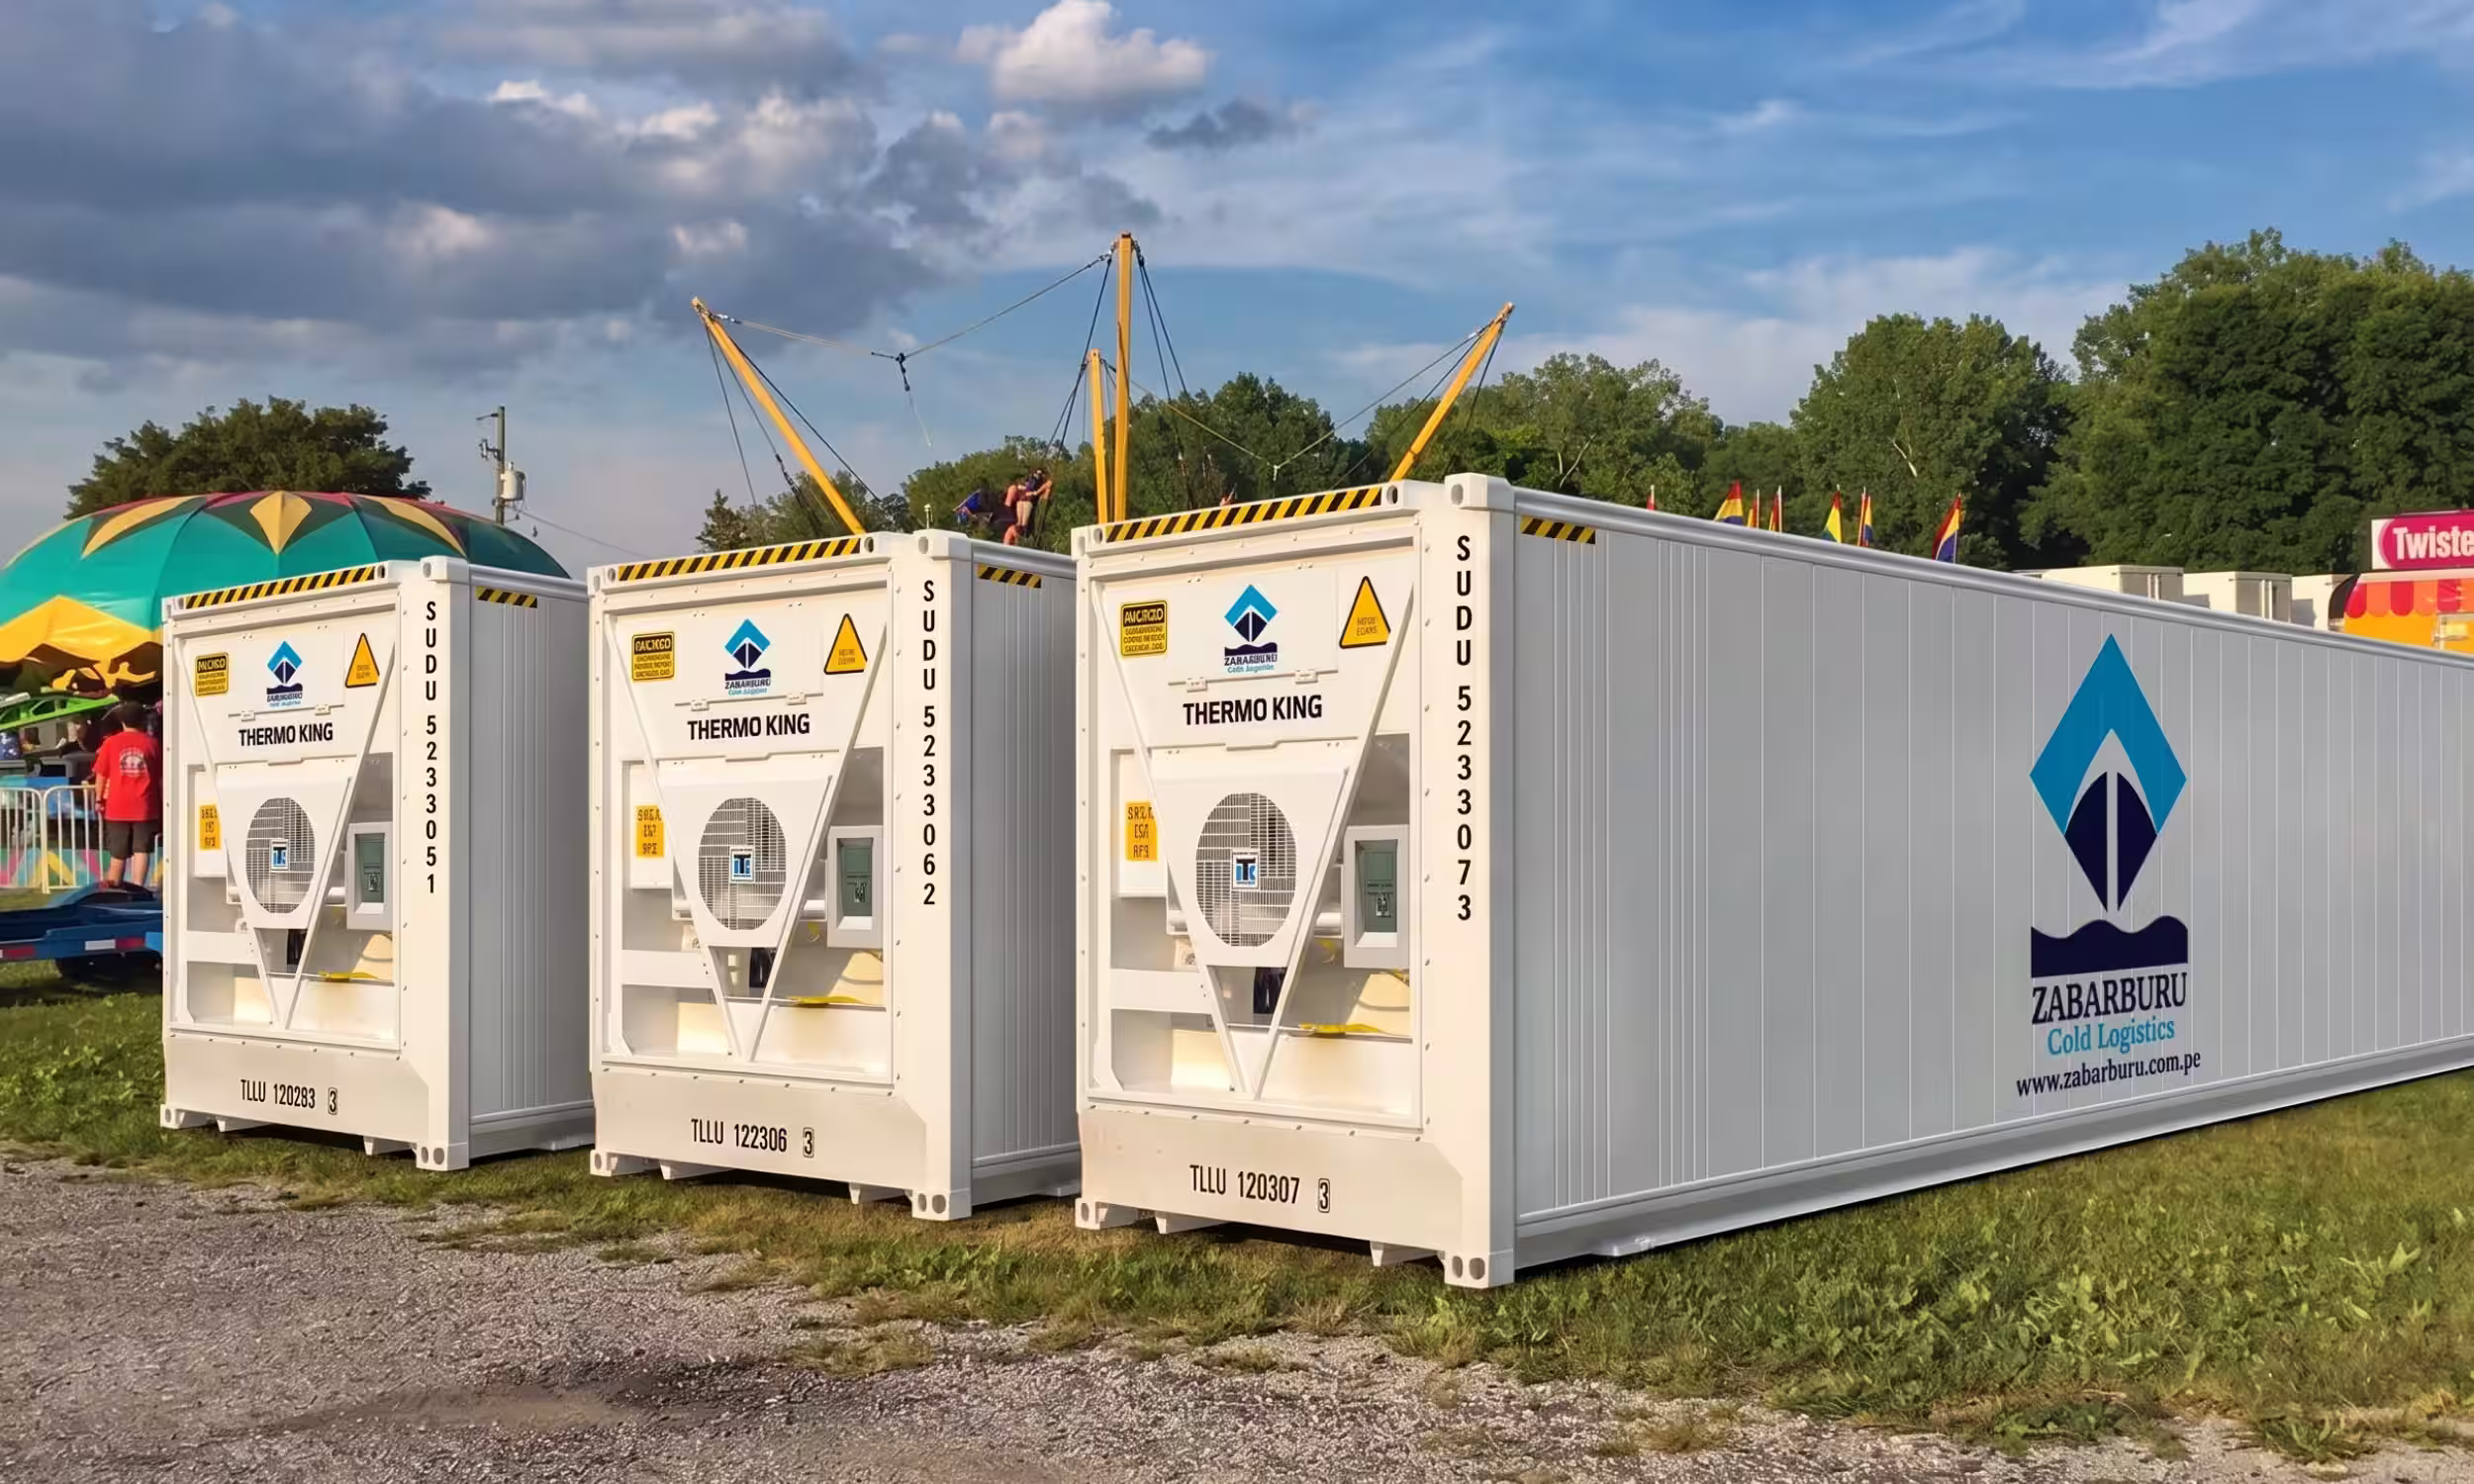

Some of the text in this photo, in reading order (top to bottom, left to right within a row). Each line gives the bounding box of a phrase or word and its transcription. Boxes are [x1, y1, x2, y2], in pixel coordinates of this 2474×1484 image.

[2393, 525, 2474, 561] Twiste
[687, 713, 809, 740] THERMO KING
[1183, 695, 1322, 725] THERMO KING
[1457, 535, 1472, 920] SUDU 5233073
[238, 722, 333, 747] THERMO KING
[426, 601, 436, 893] SUDU 5233051
[923, 580, 935, 904] SUDU 5233062
[2032, 972, 2187, 1025] ZABARBURU
[2047, 1015, 2175, 1056] Cold Logistics
[2016, 1051, 2201, 1097] www.zabarburu.com.pe
[240, 1079, 336, 1113] TLLU 120283 3
[691, 1118, 813, 1155] TLLU 122306 3
[1189, 1164, 1329, 1210] TLLU 120307 3
